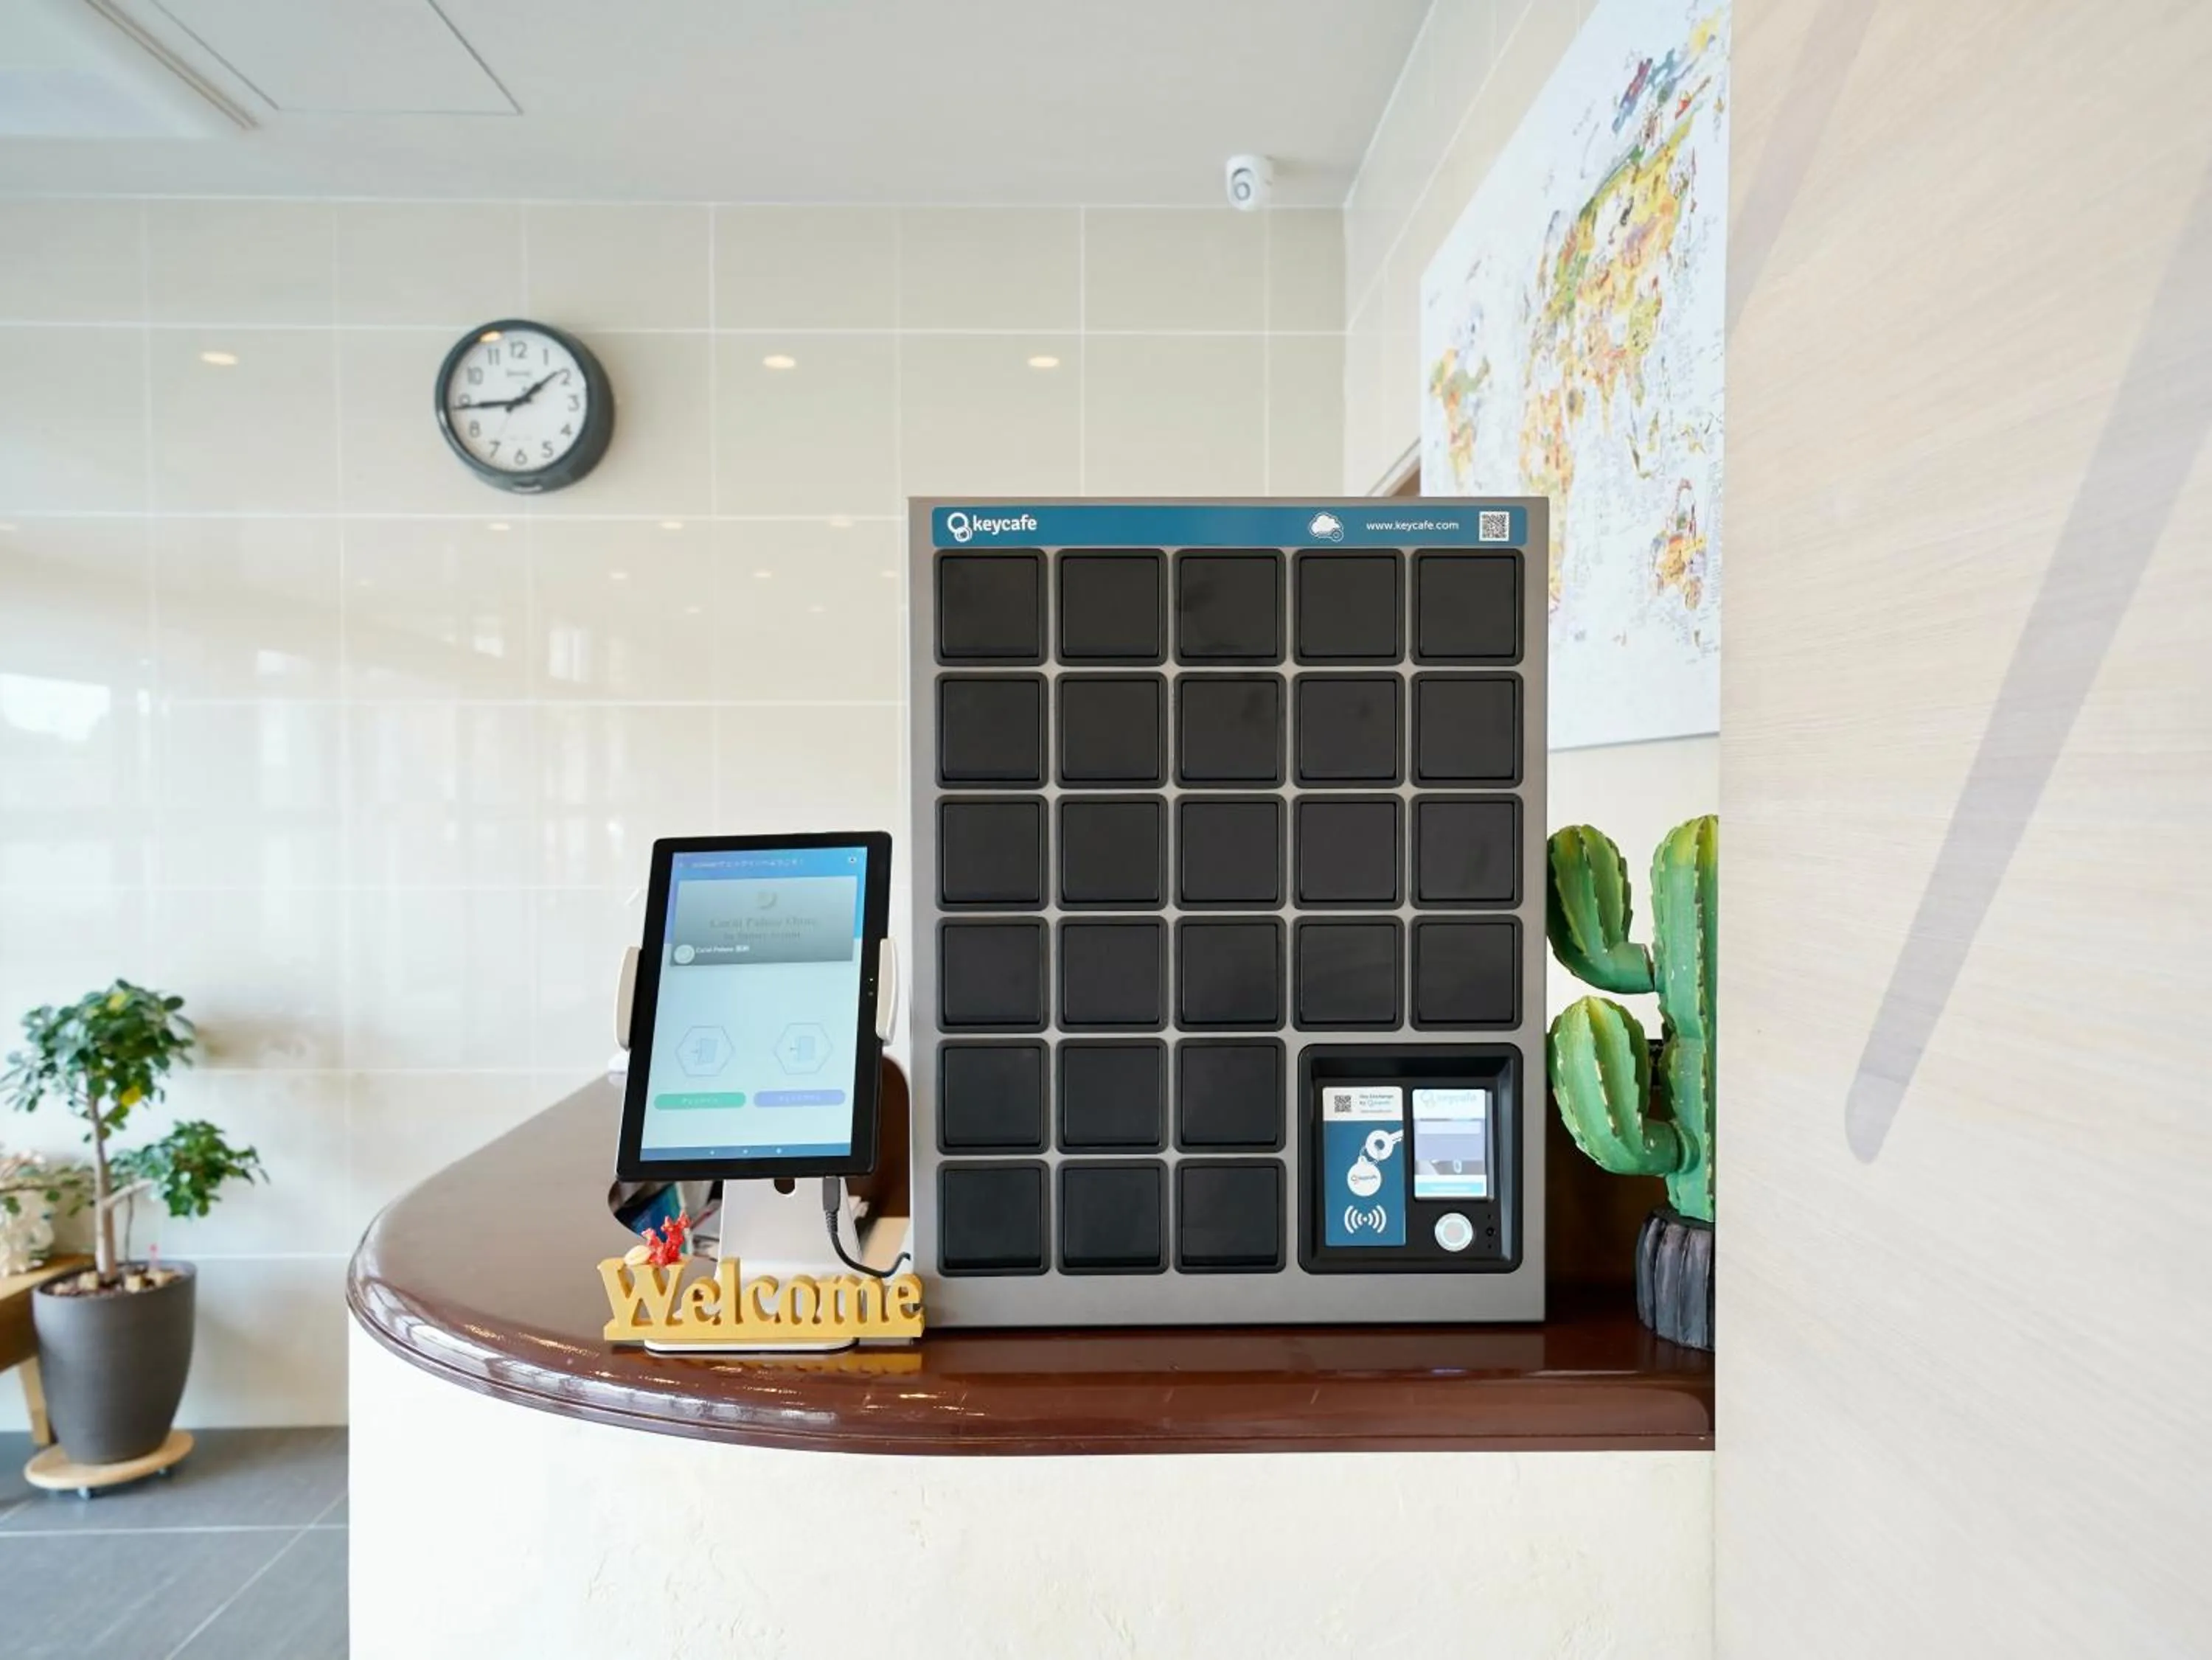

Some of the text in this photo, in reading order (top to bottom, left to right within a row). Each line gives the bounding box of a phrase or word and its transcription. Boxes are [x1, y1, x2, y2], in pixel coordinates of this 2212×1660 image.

[487, 348, 500, 366] 11
[509, 341, 527, 359] 12
[543, 348, 549, 366] 1
[467, 366, 484, 385] 10
[560, 369, 571, 385] 2
[458, 394, 470, 410] 9
[568, 395, 580, 411] 3
[469, 420, 481, 438] 8
[560, 424, 571, 436] 4
[490, 441, 501, 458] 7
[514, 449, 527, 465] 6
[542, 442, 553, 458] 5
[973, 515, 1037, 535] keycafe
[1366, 520, 1459, 531] www.keycafe.com
[597, 1257, 923, 1327] Welcome
